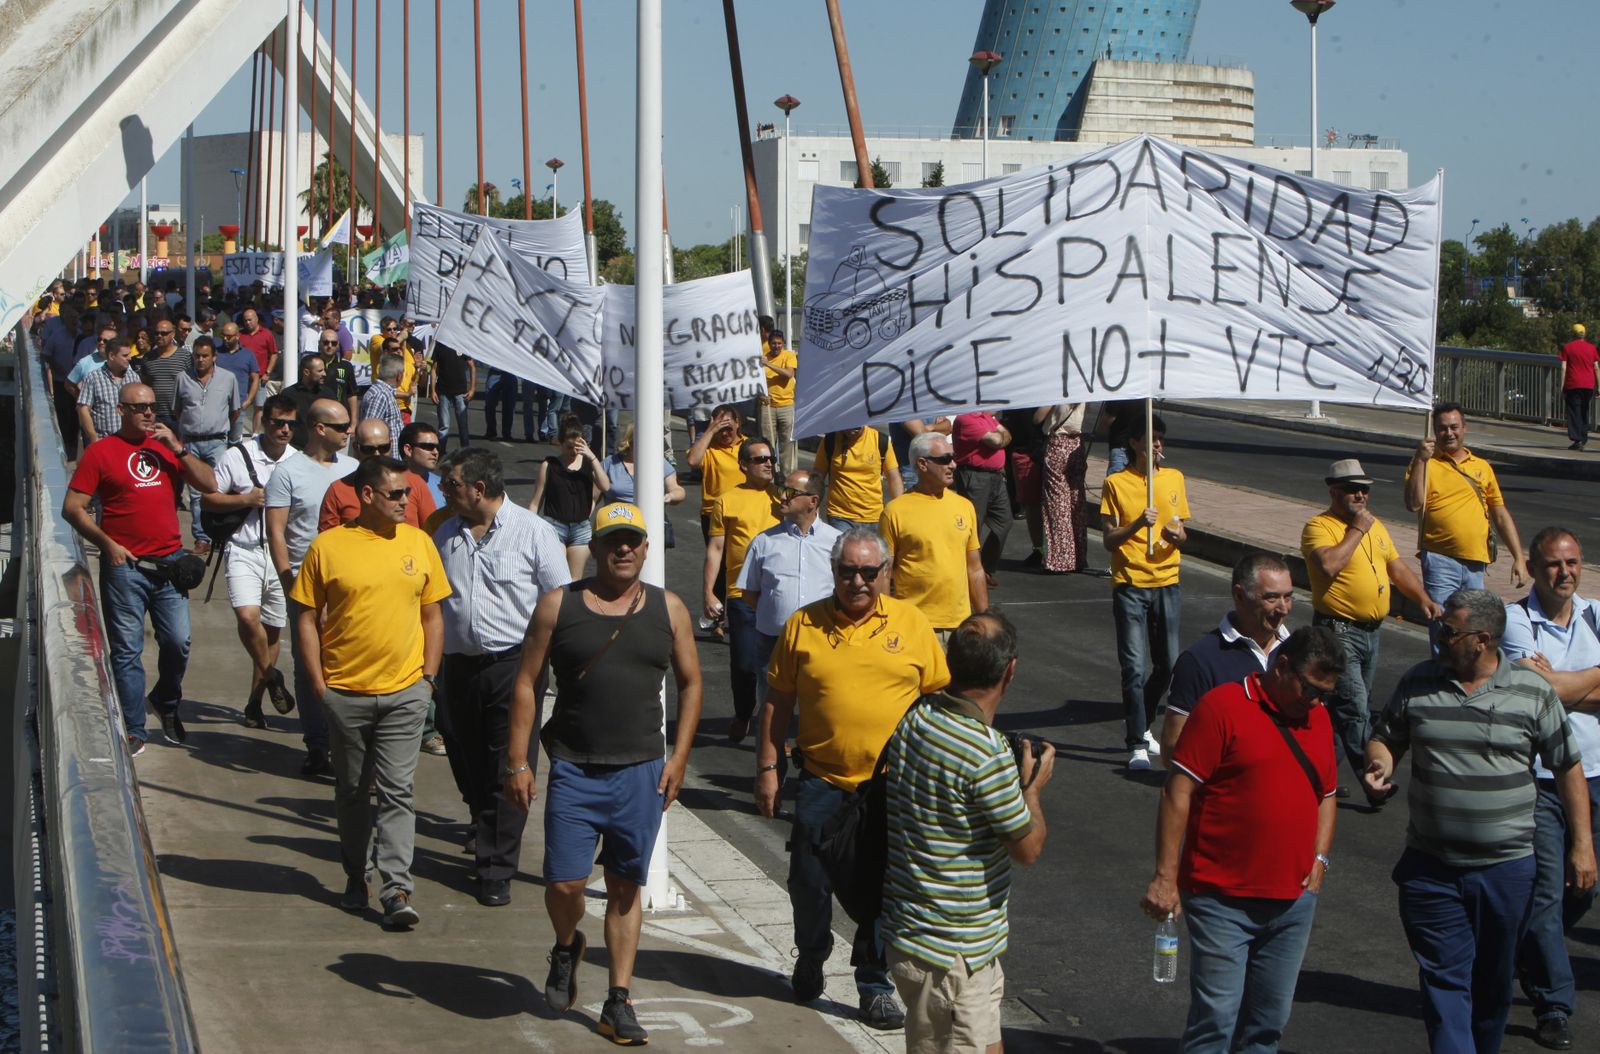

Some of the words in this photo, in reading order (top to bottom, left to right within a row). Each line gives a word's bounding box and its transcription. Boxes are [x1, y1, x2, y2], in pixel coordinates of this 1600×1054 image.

[417, 211, 452, 239] EL
[454, 221, 512, 249] TAi
[130, 253, 169, 269] Mgica
[225, 256, 252, 276] ESTA
[1225, 325, 1337, 392] VTC
[134, 480, 162, 488] VOLCOM
